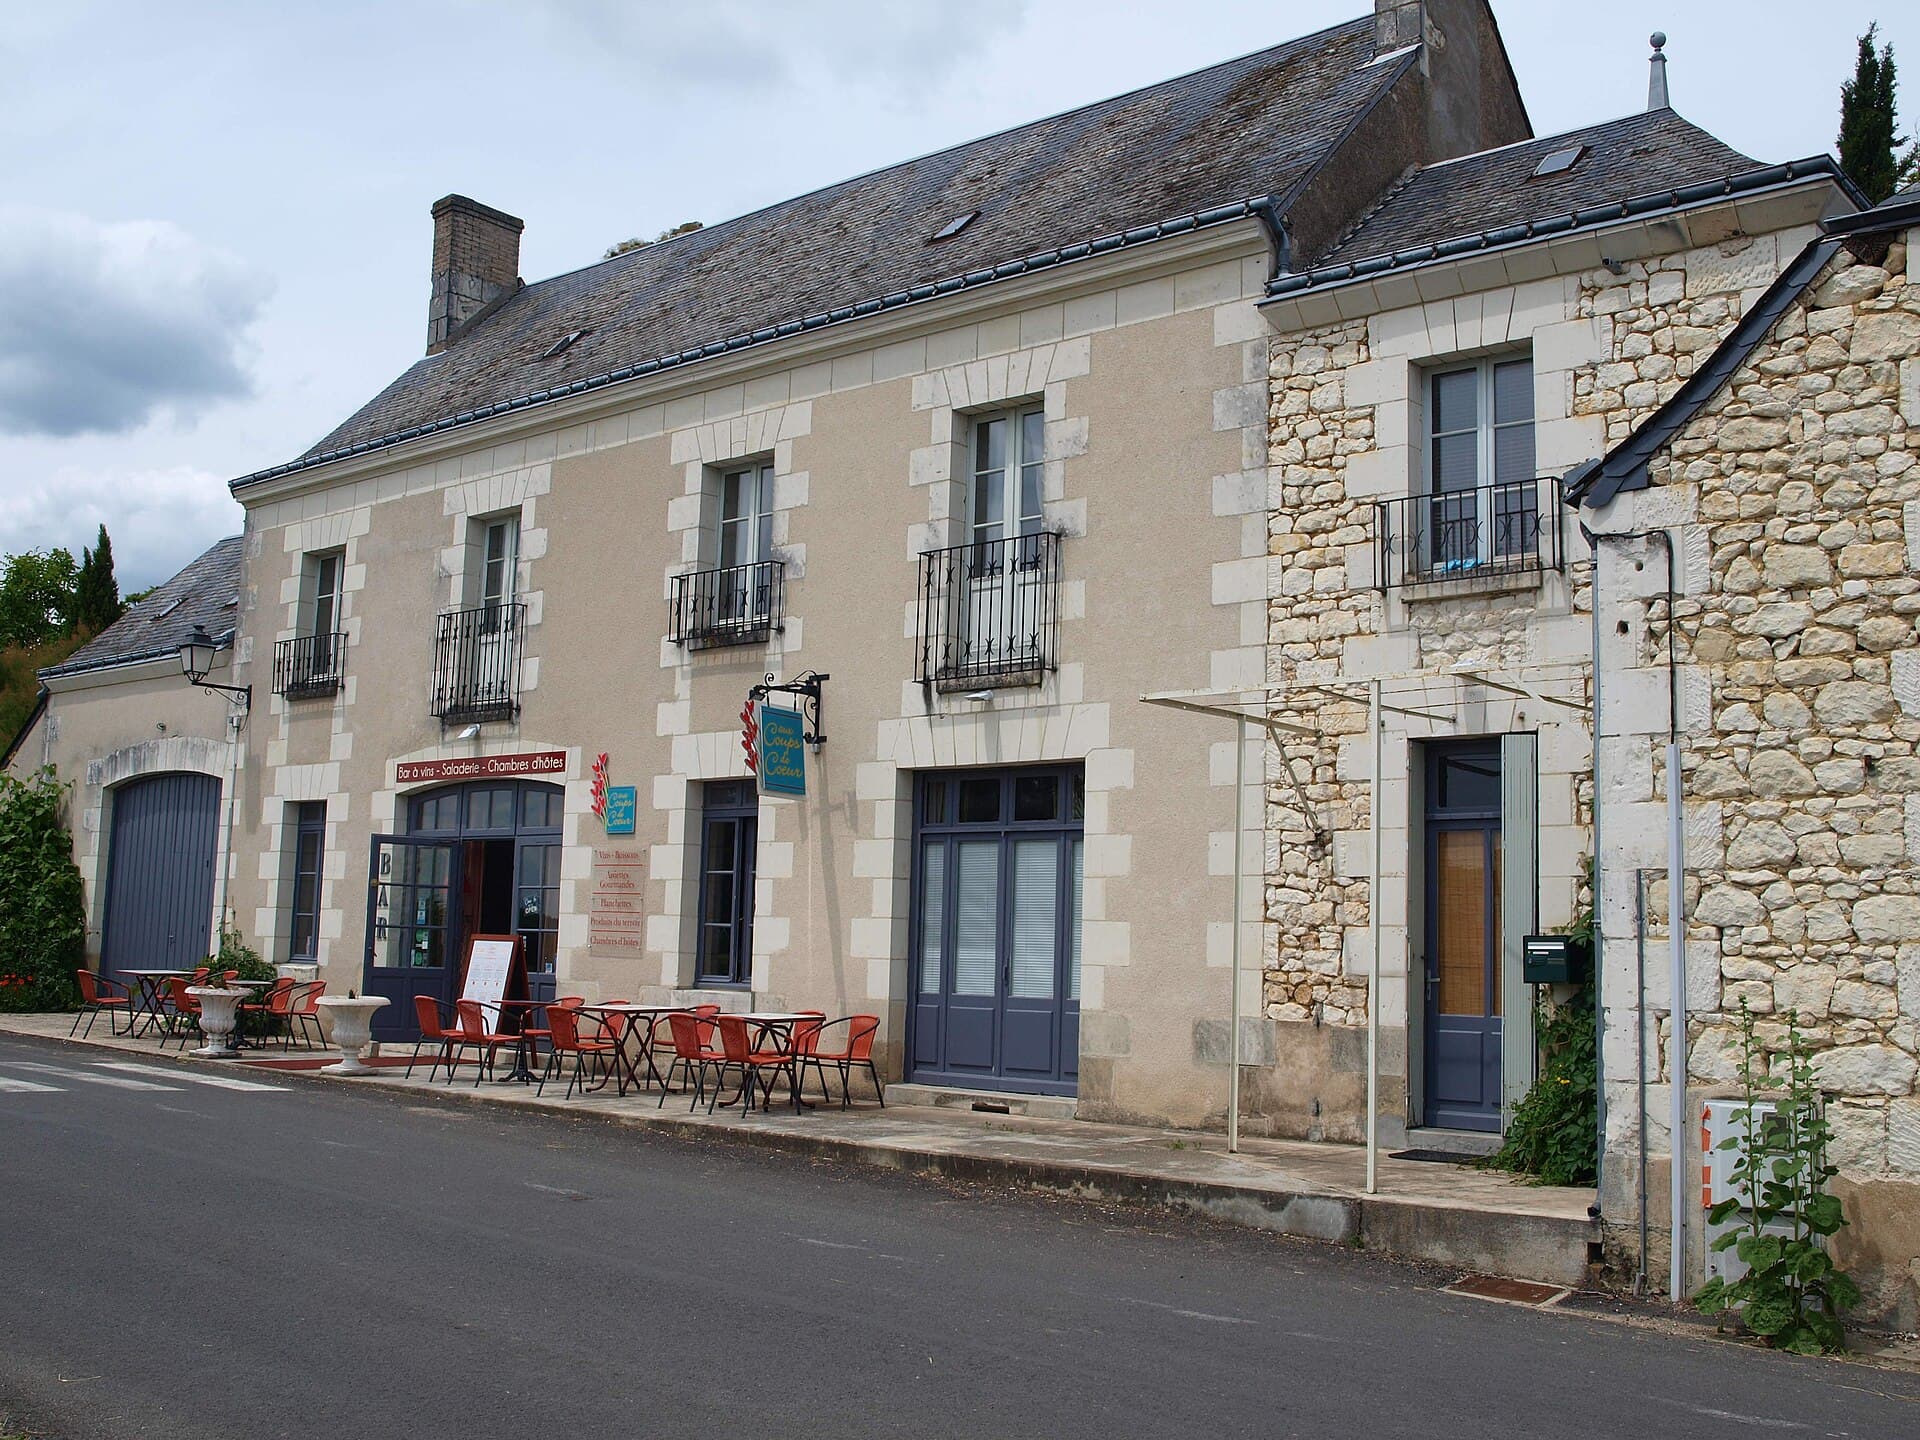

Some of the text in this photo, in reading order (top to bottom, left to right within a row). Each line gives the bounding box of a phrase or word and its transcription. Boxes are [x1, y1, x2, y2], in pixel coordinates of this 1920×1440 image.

[764, 722, 802, 748] Coups
[398, 766, 410, 779] Bar
[412, 766, 419, 778] à
[420, 767, 434, 778] vins
[441, 762, 480, 776] Saladerie
[487, 758, 529, 773] Chambres
[532, 755, 564, 770] d'hôtes
[376, 852, 392, 941] BAR
[613, 917, 621, 926] du
